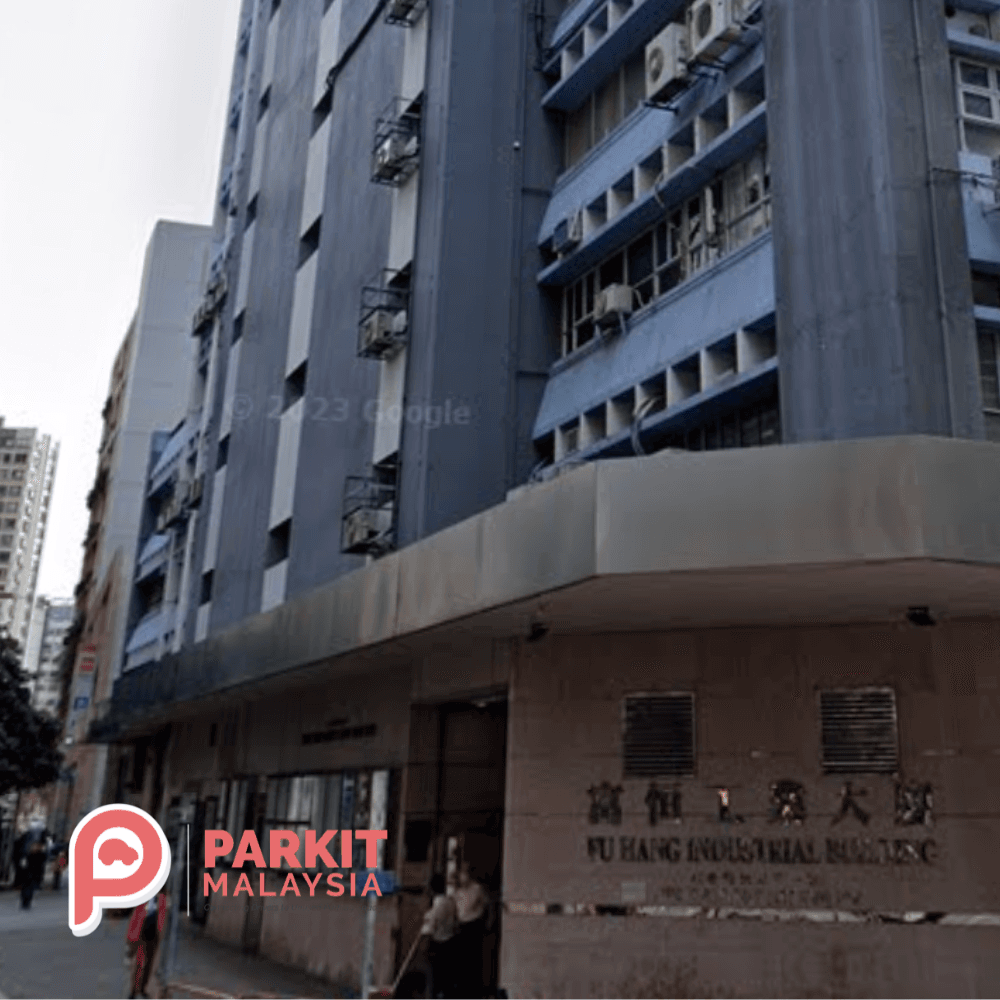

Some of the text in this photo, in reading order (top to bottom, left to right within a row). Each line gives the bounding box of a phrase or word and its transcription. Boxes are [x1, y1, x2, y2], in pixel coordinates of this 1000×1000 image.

[587, 836, 614, 863] FU
[619, 836, 682, 863] HANG
[686, 836, 822, 864] INDUSTRIAL
